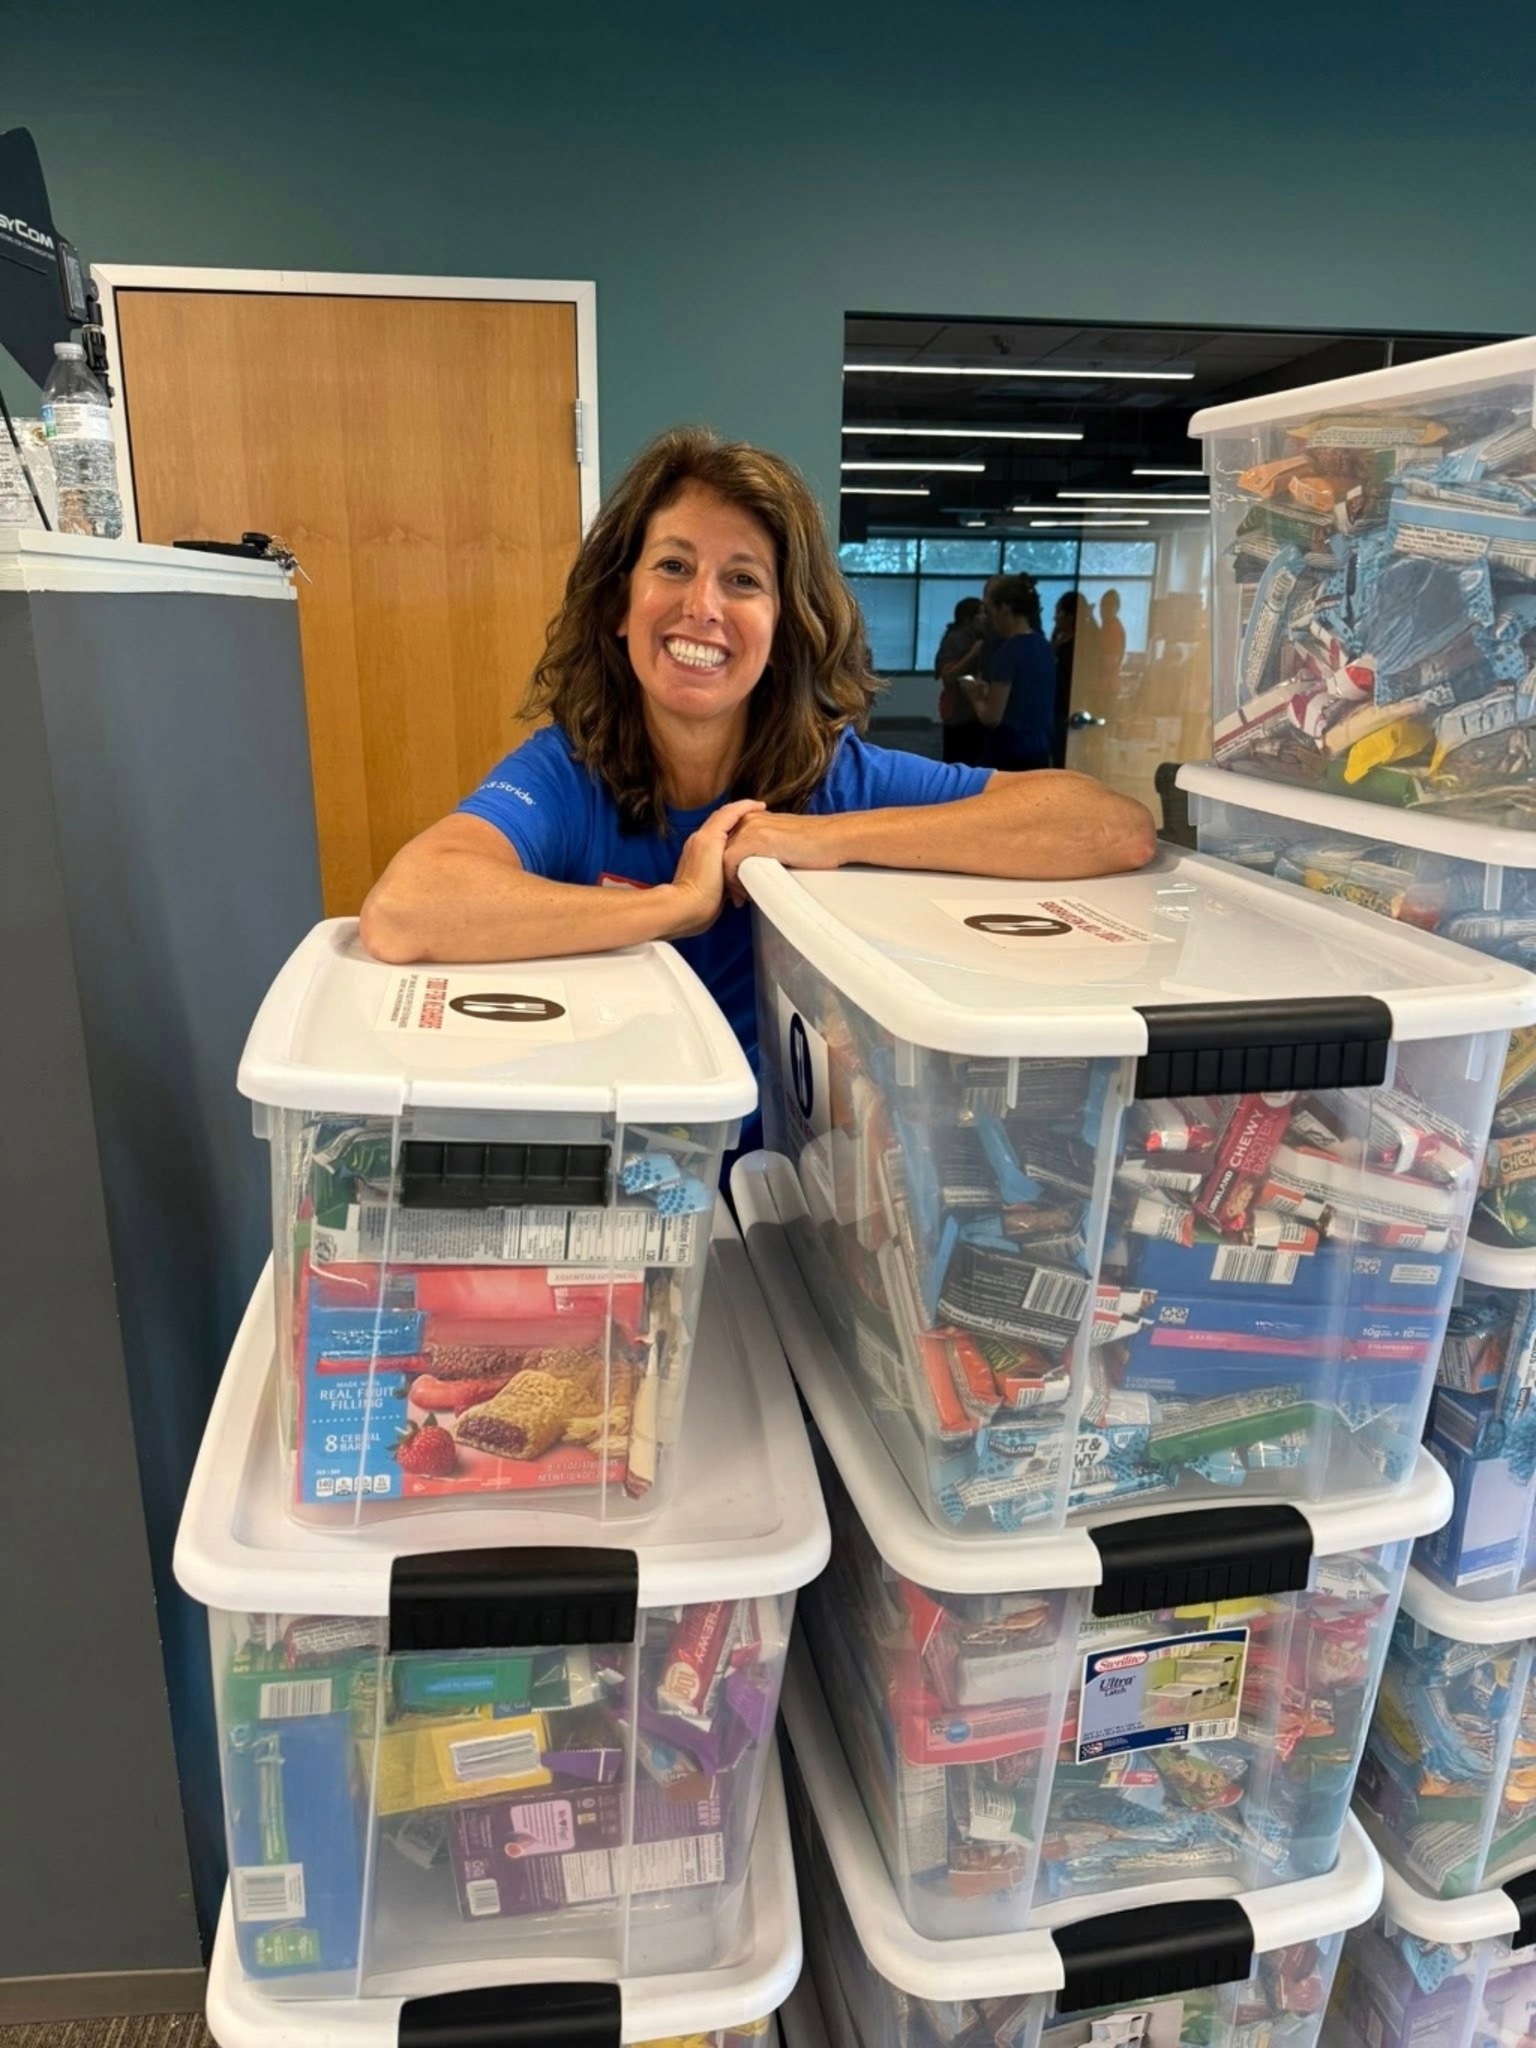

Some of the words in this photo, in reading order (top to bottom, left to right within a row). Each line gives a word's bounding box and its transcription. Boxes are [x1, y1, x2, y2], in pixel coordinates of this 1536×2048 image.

[497, 781, 534, 805] Stride
[1229, 1108, 1264, 1168] CHEWY
[1241, 1110, 1279, 1171] PROTEIN
[1252, 1144, 1275, 1175] BAR
[1207, 1170, 1234, 1213] KIRKLAND
[320, 1389, 352, 1400] REAL
[325, 1434, 337, 1453] 8
[1099, 1655, 1141, 1670] Sterilite
[1099, 1678, 1133, 1692] Ultra
[1104, 1687, 1127, 1698] Latch
